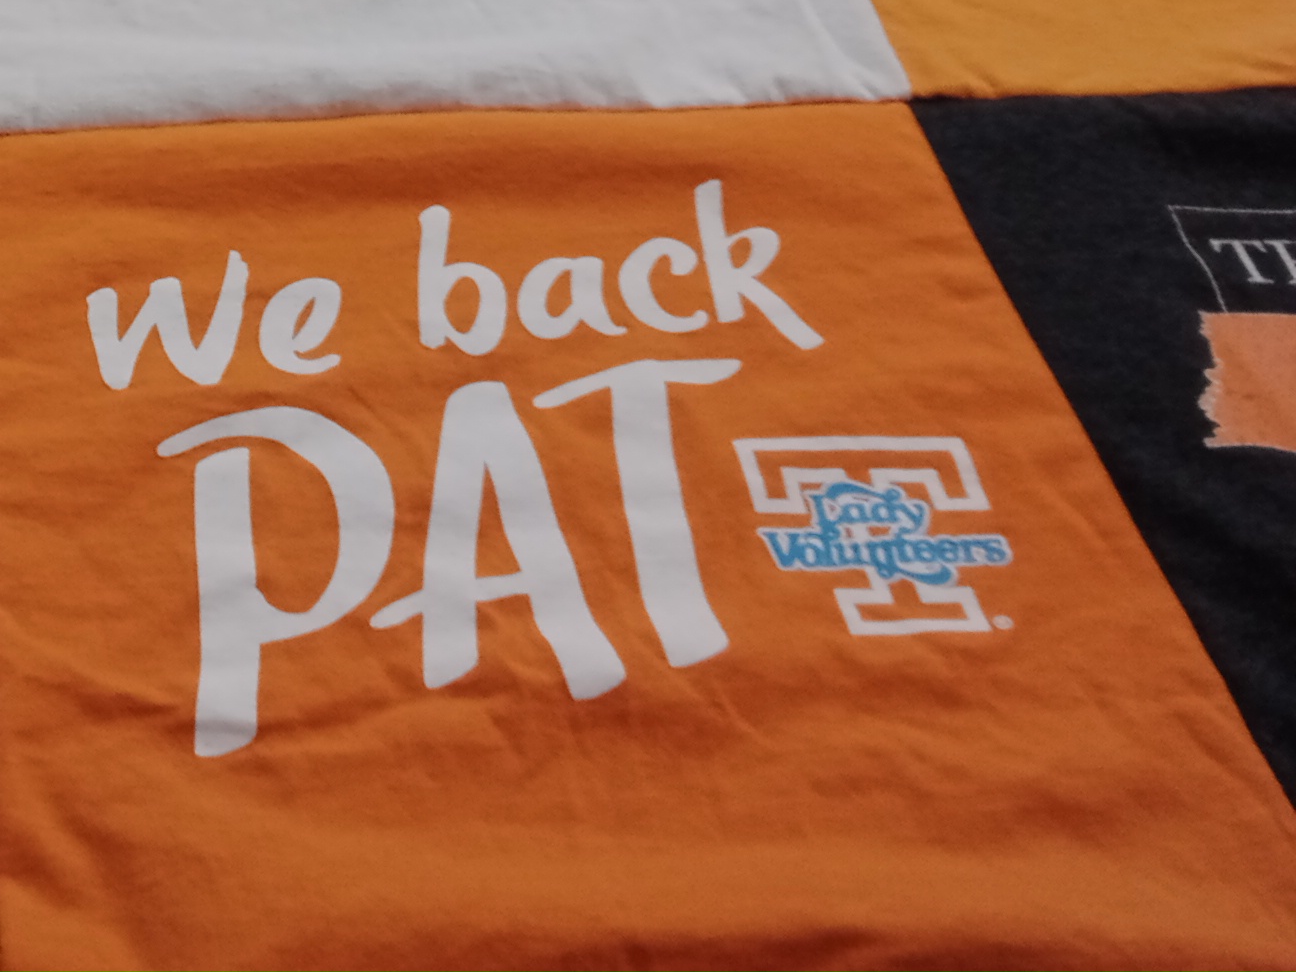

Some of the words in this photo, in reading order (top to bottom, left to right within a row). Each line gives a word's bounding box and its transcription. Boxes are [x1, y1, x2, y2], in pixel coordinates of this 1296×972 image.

[417, 178, 825, 357] back
[156, 358, 743, 758] PAT
[760, 525, 1010, 586] Volunteers
[806, 482, 930, 540] Lady
